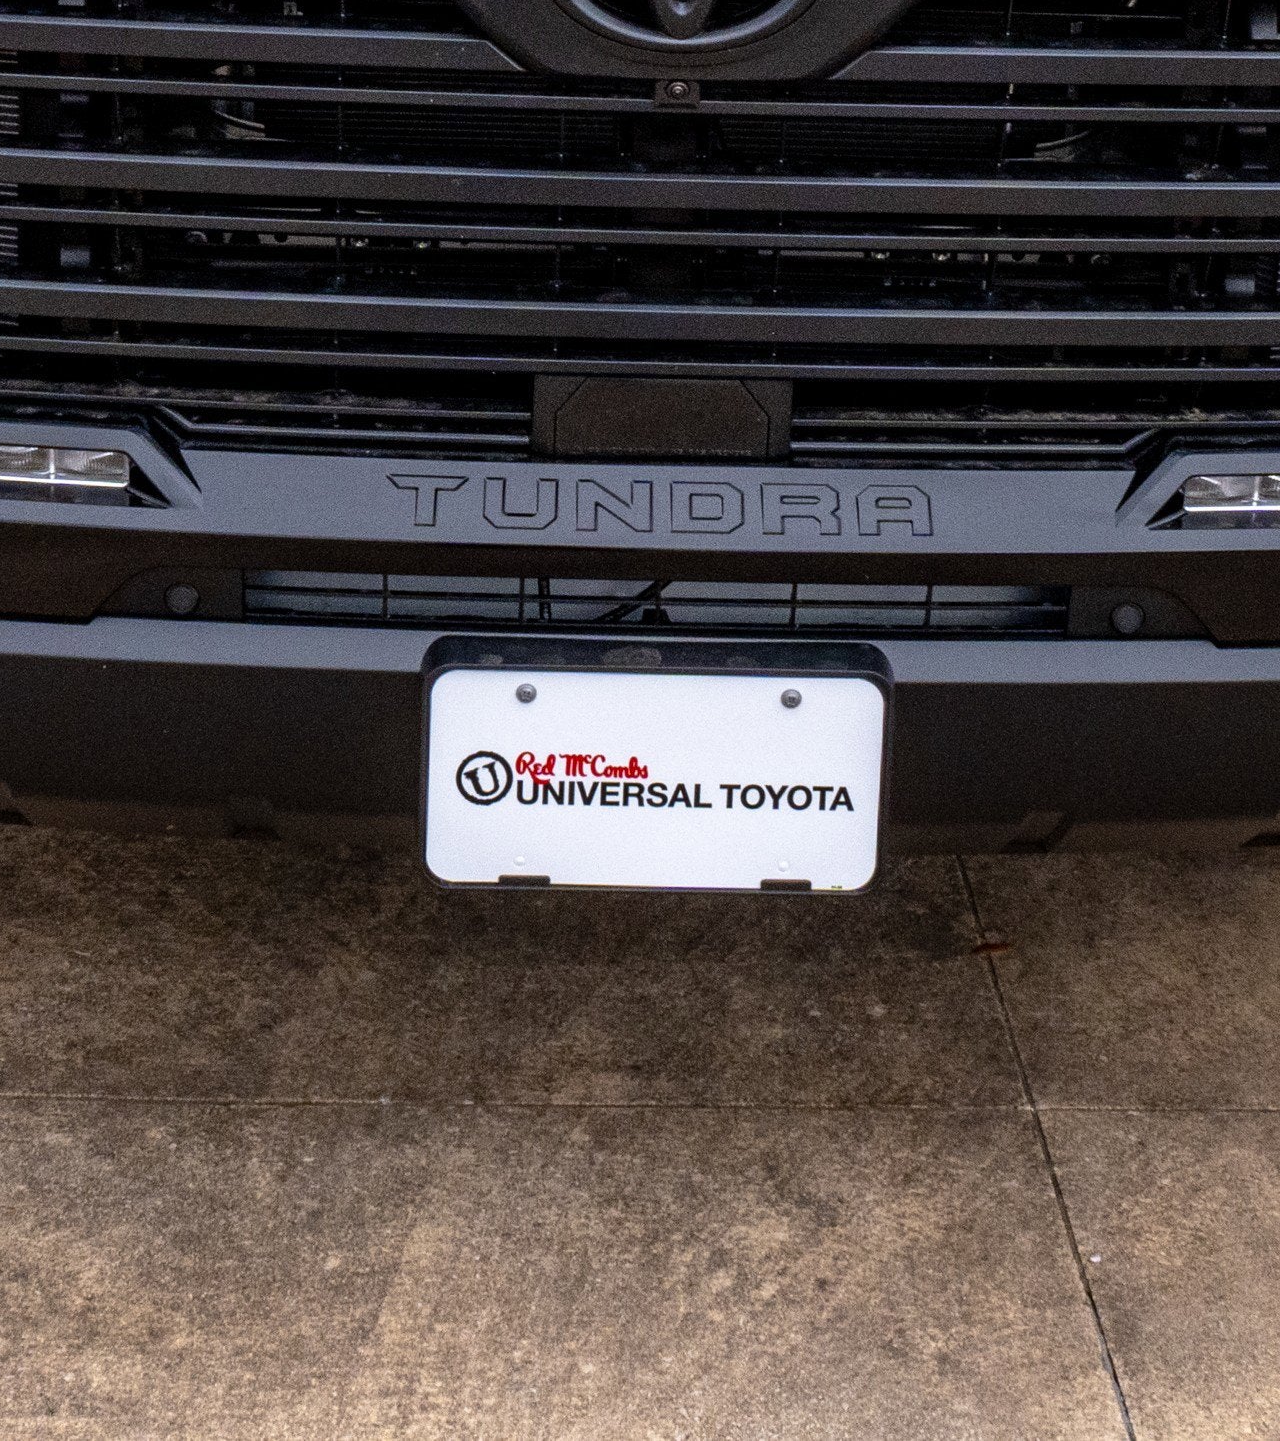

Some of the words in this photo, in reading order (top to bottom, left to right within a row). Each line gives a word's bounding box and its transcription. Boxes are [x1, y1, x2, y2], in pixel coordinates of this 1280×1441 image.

[386, 473, 933, 536] TUNDRA
[515, 751, 556, 785] Red
[517, 780, 712, 808] UNIVERSAL
[720, 784, 854, 811] TOYOTA
